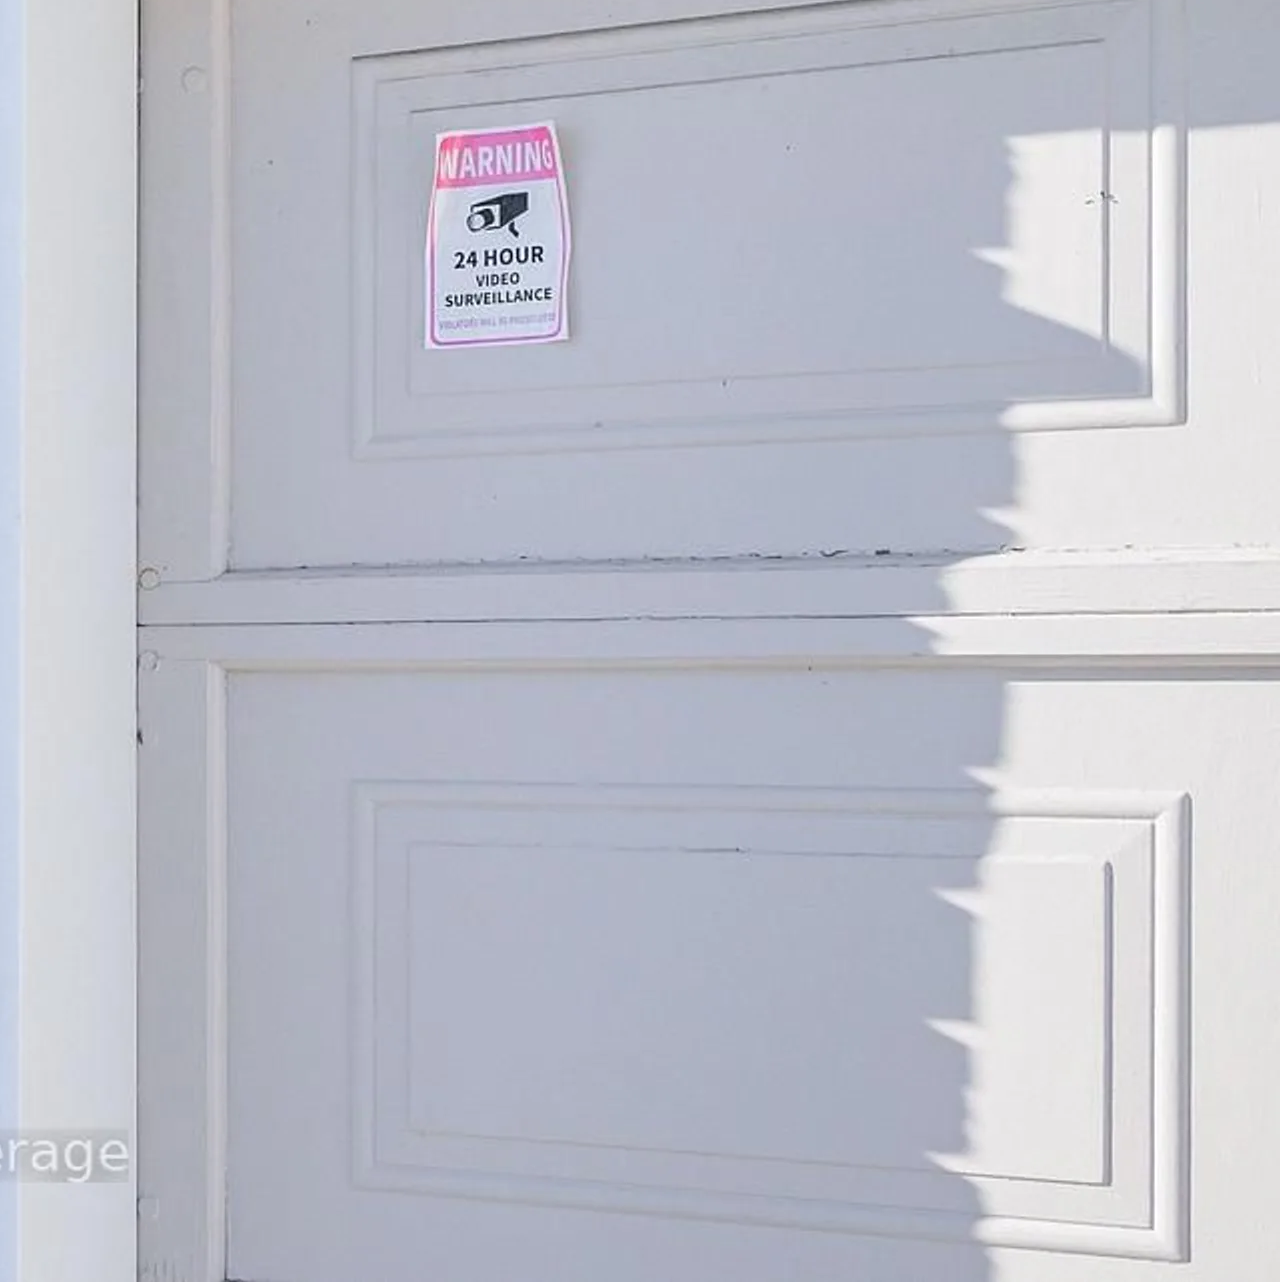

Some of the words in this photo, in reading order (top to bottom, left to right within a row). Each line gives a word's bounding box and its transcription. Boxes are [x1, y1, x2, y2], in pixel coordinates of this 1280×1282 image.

[441, 138, 553, 180] WARNING
[454, 250, 478, 269] 24
[484, 245, 544, 267] HOUR
[476, 272, 520, 287] VIDEO
[445, 287, 552, 307] SURVEILLANCE
